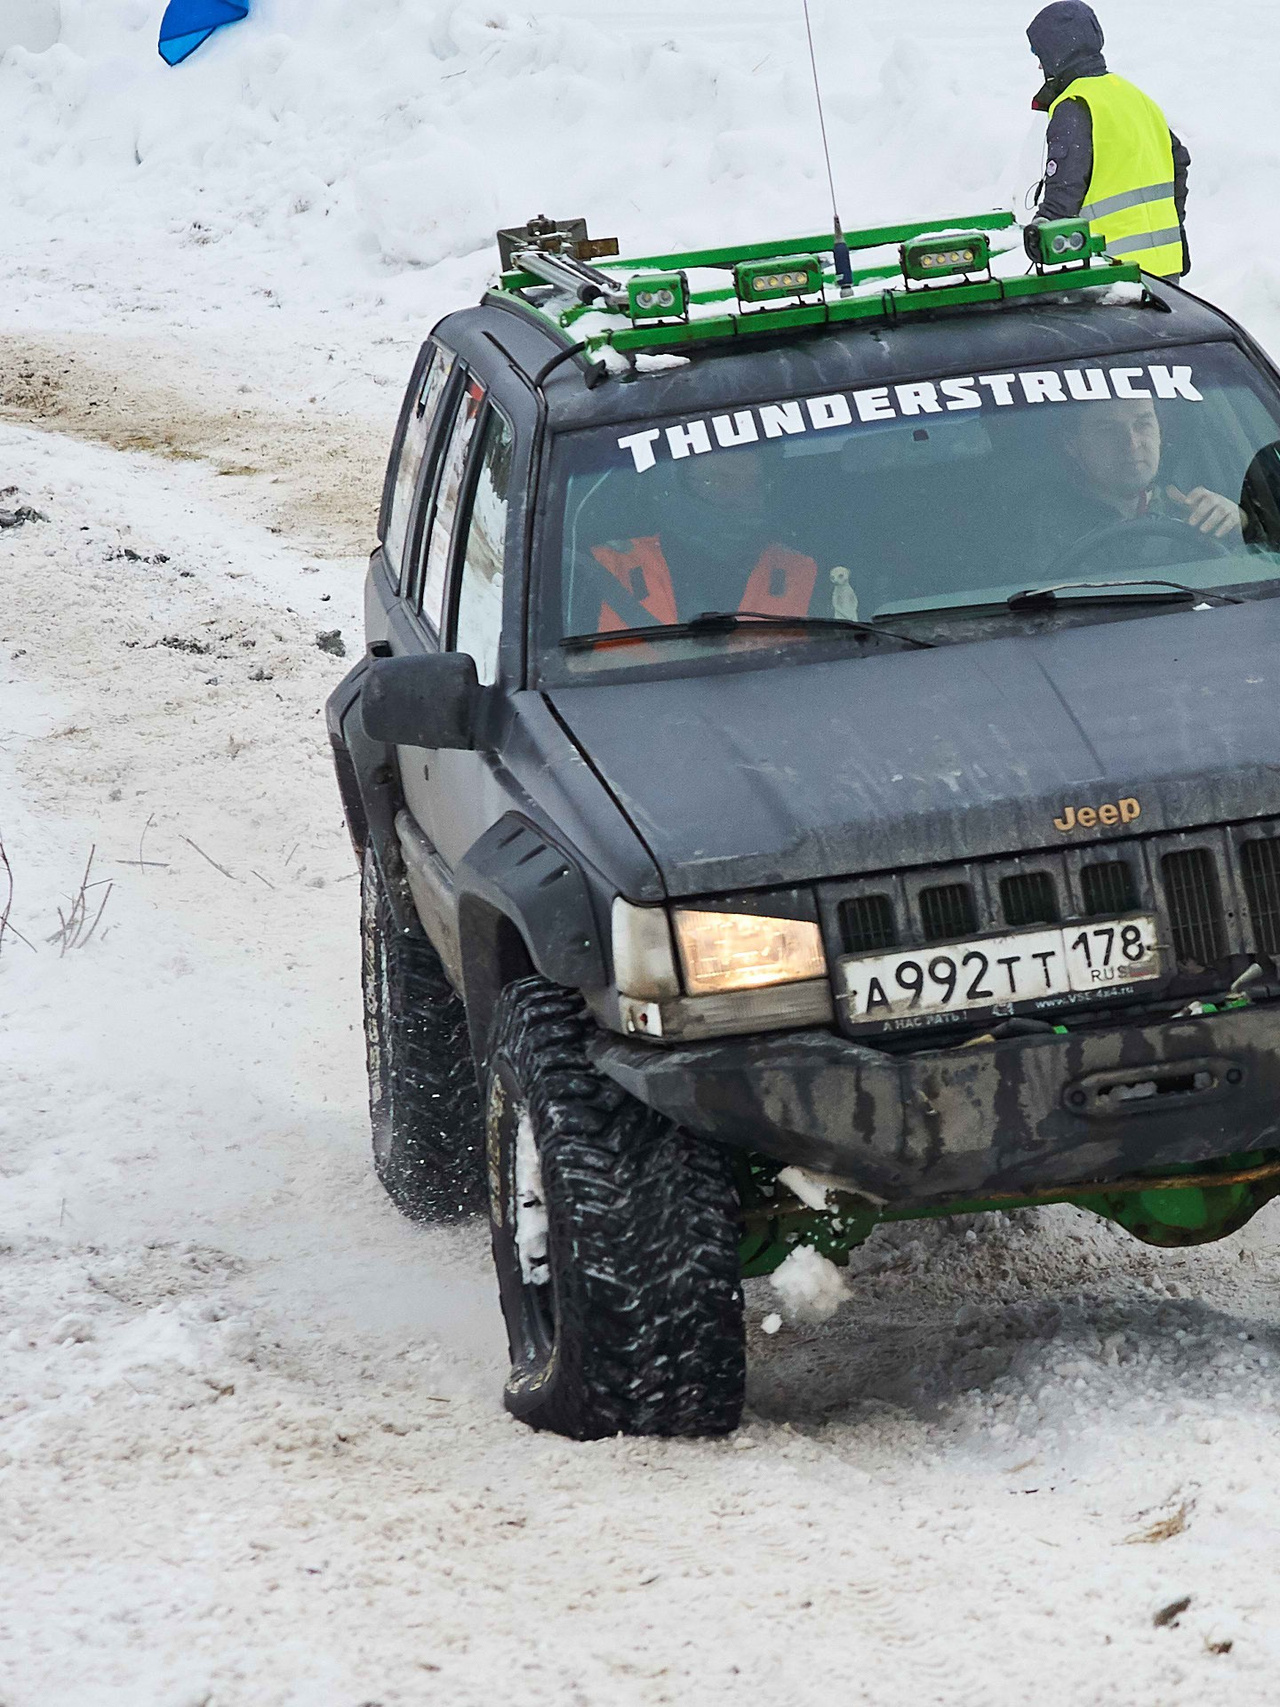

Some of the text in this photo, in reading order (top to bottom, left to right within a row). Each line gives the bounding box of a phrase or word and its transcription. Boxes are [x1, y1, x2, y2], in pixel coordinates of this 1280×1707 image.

[618, 364, 1204, 473] THUNDERSTRUCK
[1053, 797, 1141, 831] Jeep
[1071, 924, 1145, 968] 178
[1090, 964, 1128, 982] RUS
